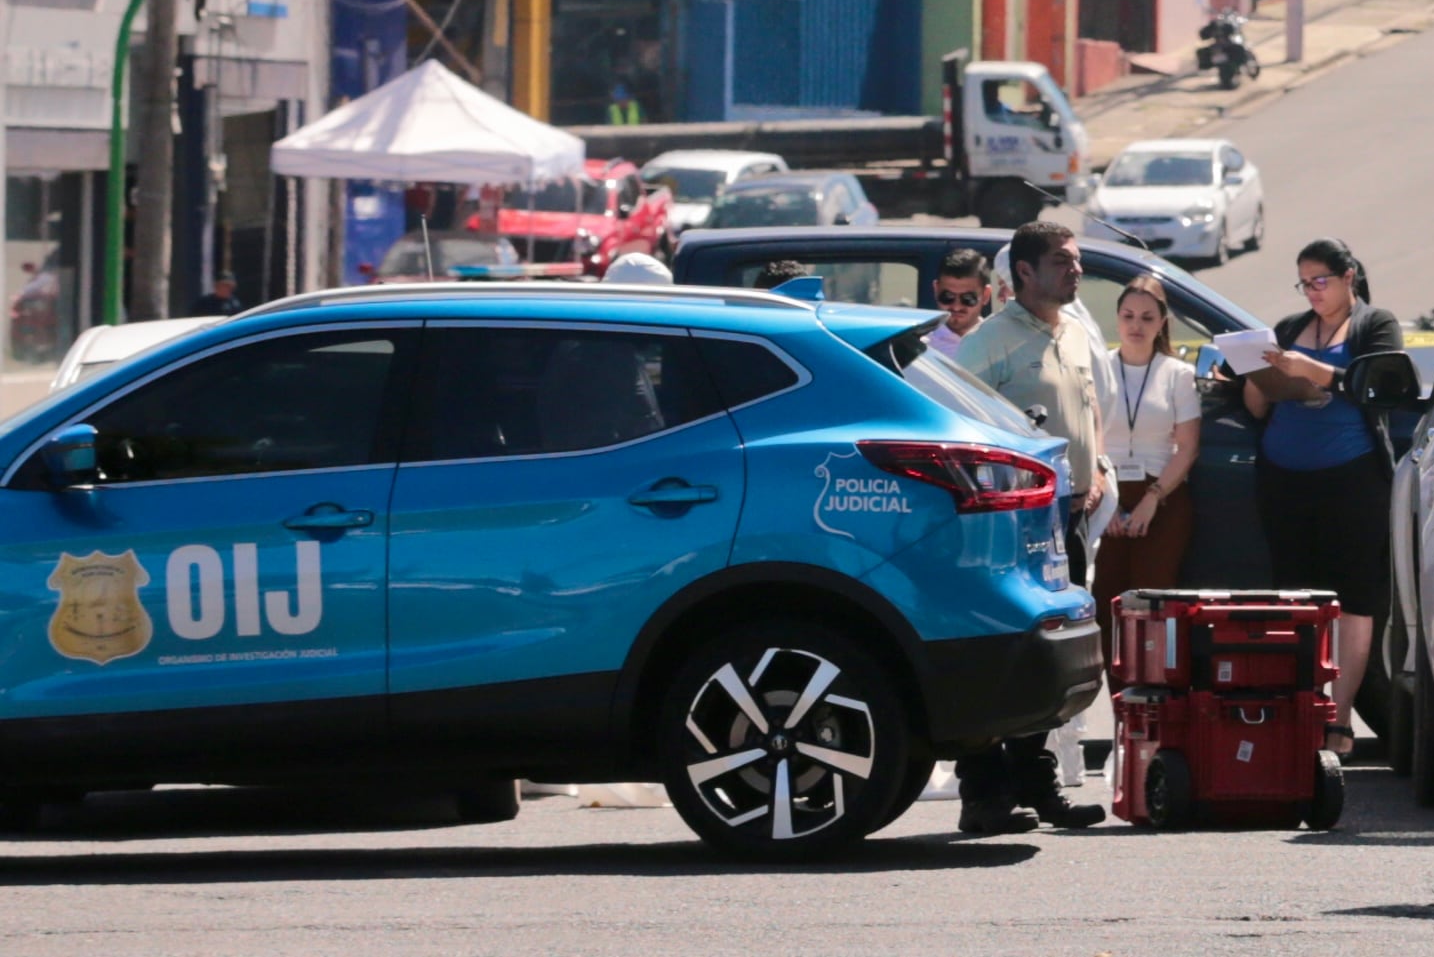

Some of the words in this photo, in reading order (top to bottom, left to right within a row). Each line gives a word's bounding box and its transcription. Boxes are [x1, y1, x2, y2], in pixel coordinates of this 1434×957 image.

[836, 478, 900, 493] POLICIA
[824, 495, 912, 513] JUDICIAL
[166, 540, 322, 640] OIJ
